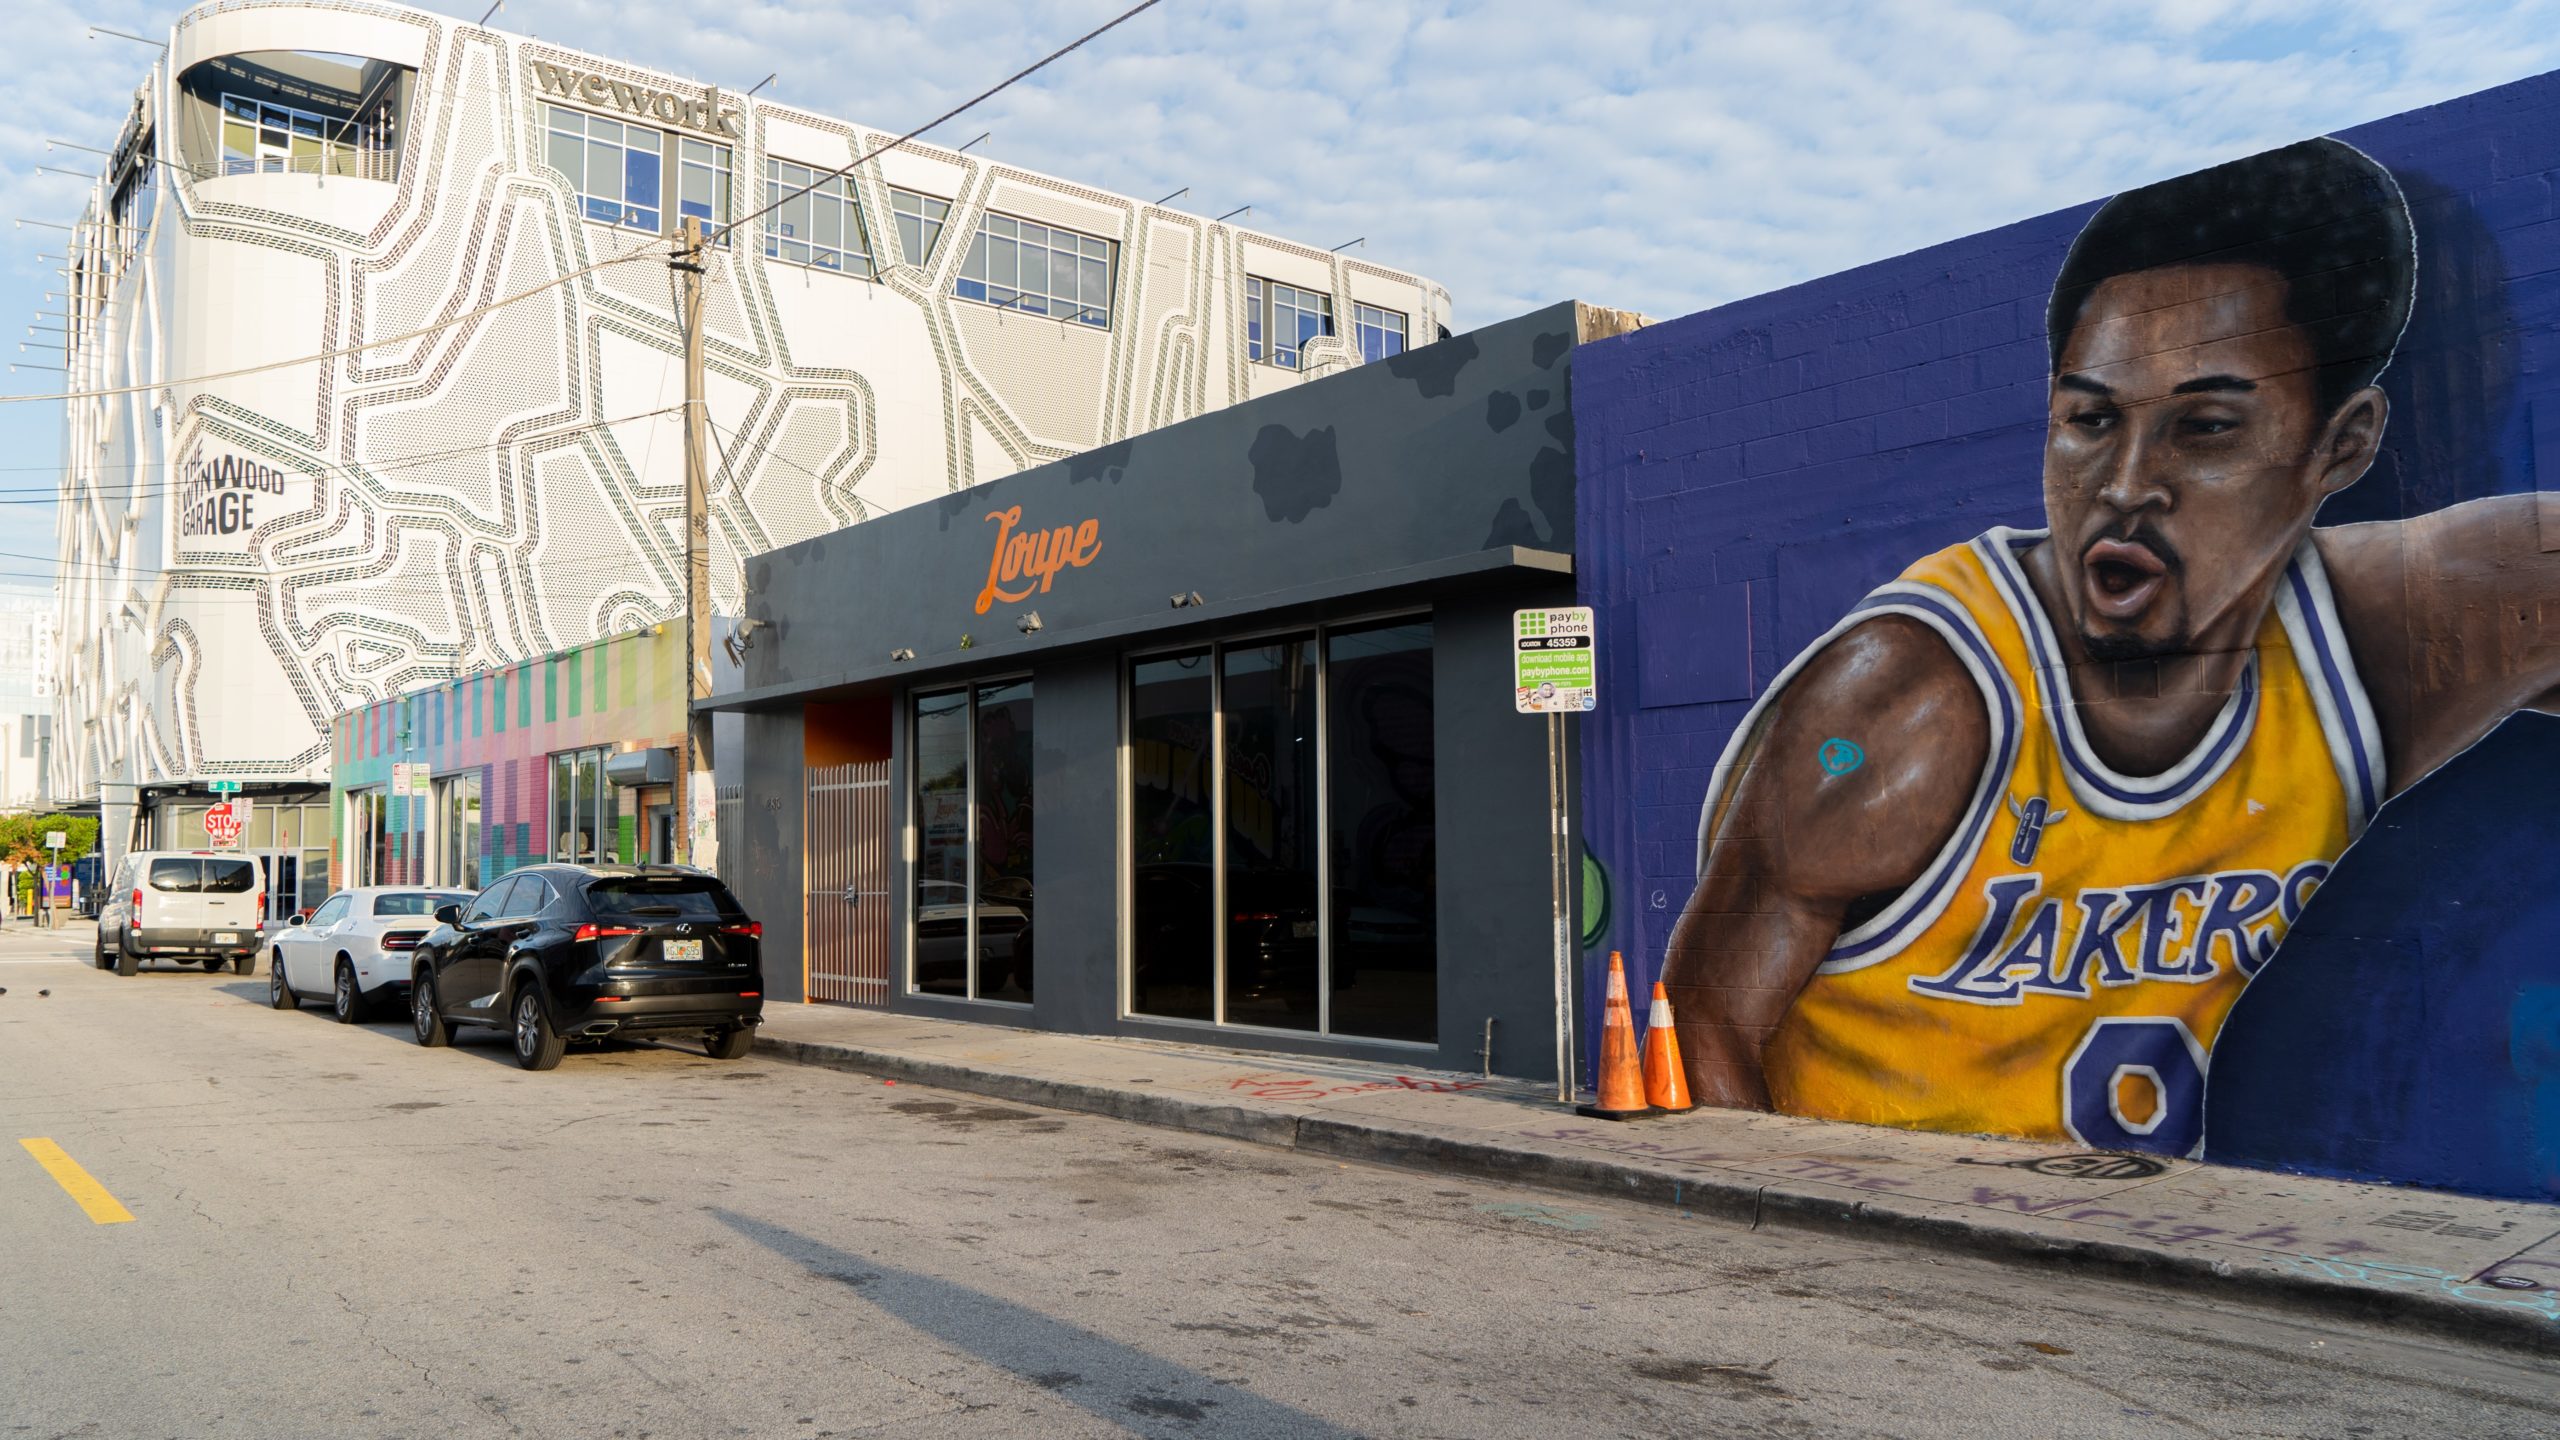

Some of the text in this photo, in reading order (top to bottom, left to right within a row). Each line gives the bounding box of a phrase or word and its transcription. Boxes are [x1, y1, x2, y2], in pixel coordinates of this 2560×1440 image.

[532, 60, 741, 137] wework
[183, 438, 203, 485] THE
[183, 454, 285, 512] WYNWOOD
[182, 491, 254, 537] GARAGE
[975, 505, 1103, 615] Loupe
[1546, 637, 1577, 648] 45359
[1550, 624, 1588, 635] phone
[1521, 652, 1588, 664] download mobile app
[1522, 666, 1588, 678] paybyphone.com
[222, 781, 229, 790] 3
